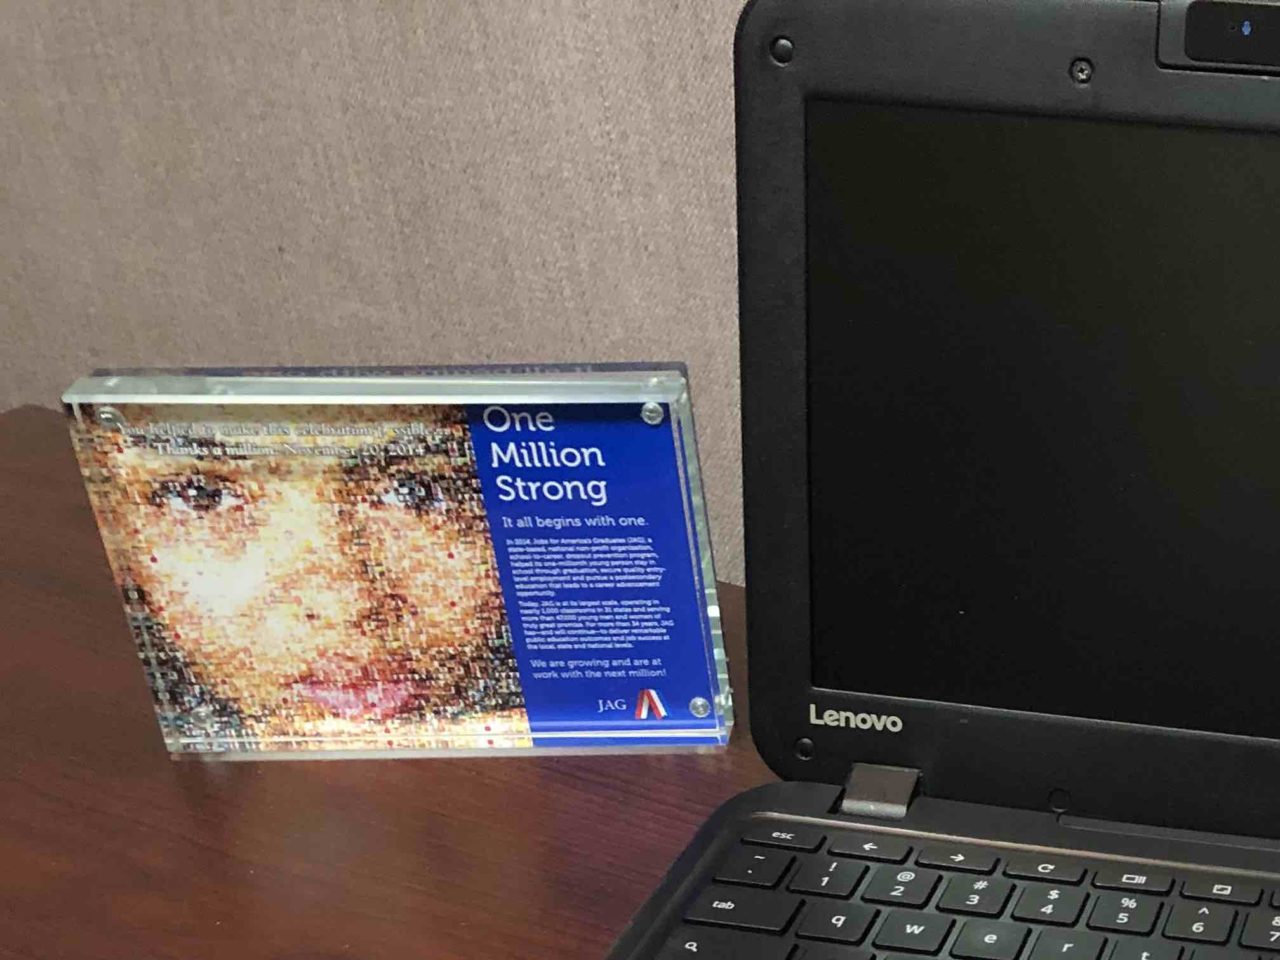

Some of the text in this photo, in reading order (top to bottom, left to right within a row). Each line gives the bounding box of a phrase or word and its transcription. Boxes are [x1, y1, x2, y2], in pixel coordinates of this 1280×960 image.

[483, 405, 556, 432] One
[153, 442, 209, 456] Thanks
[389, 442, 426, 456] 2014
[491, 441, 606, 468] Million
[496, 475, 608, 507] Strong
[502, 515, 650, 530] It all begins with one.
[530, 659, 547, 668] We
[549, 660, 565, 668] are
[567, 658, 610, 669] growing
[611, 658, 632, 667] and
[651, 658, 663, 666] at
[533, 668, 667, 679] work with the next million!
[597, 698, 628, 712] JAG
[809, 703, 903, 733] Lenovo
[771, 831, 795, 840] esc
[821, 876, 830, 887] 1
[890, 885, 905, 896] 2
[712, 900, 735, 910] tab
[965, 894, 980, 905] 3
[1040, 904, 1054, 915] 4
[831, 915, 847, 928] q
[1116, 912, 1129, 924] 5
[905, 924, 925, 935] w
[1191, 922, 1205, 933] 6
[983, 934, 998, 944] e
[1269, 931, 1280, 942] 7
[1061, 943, 1074, 953] r
